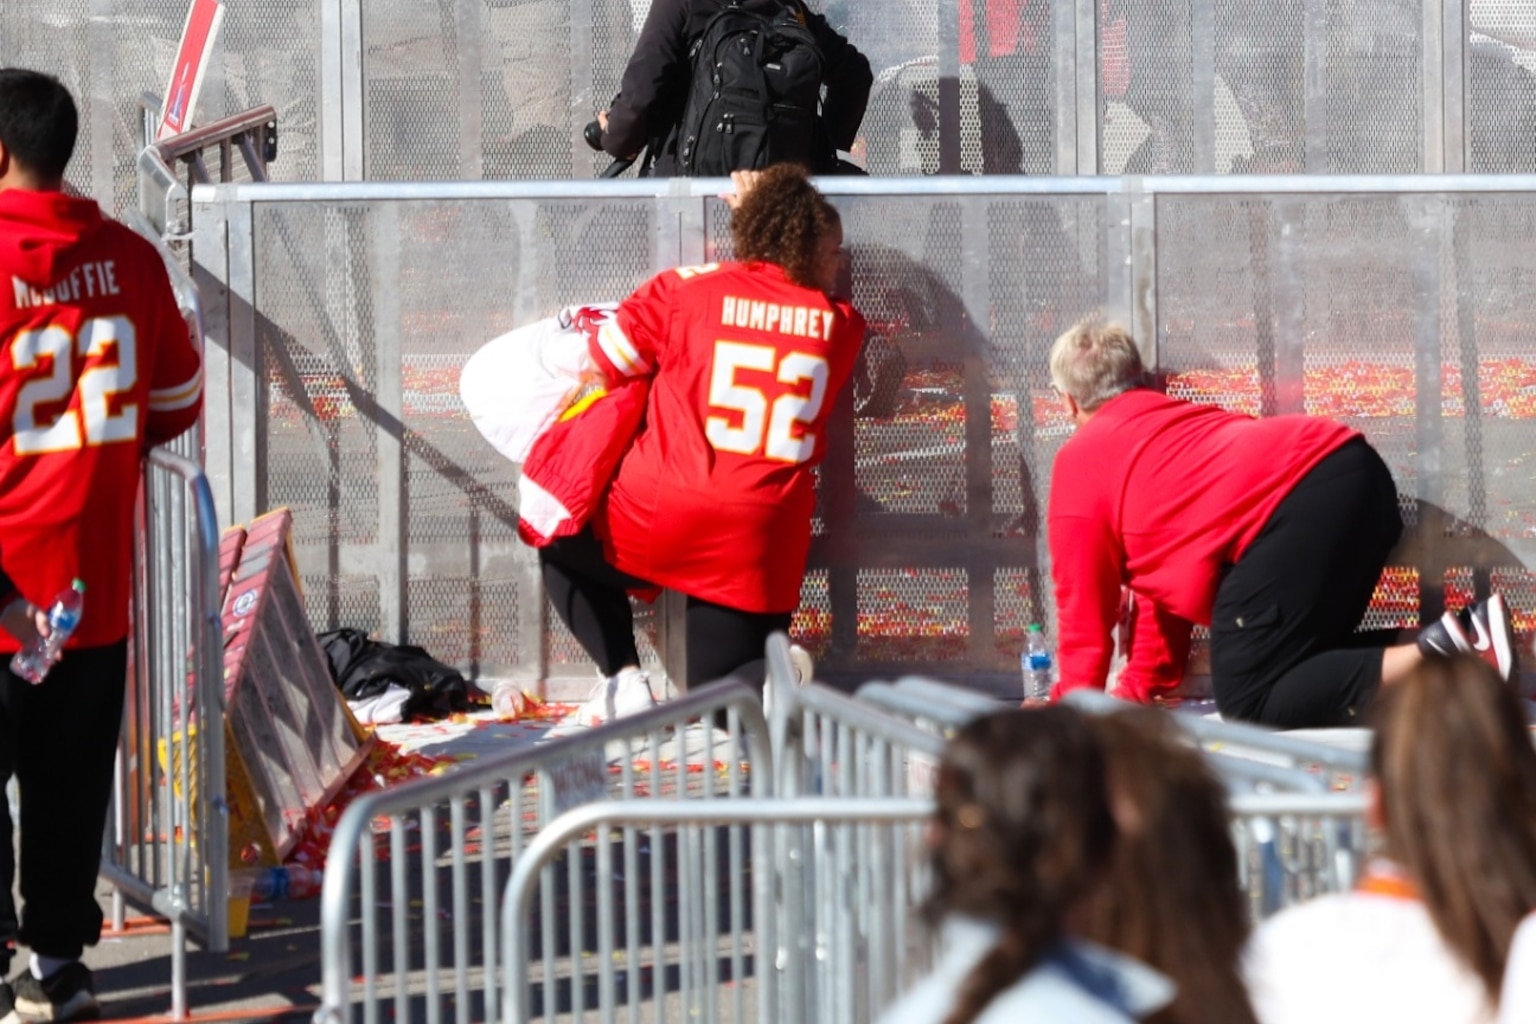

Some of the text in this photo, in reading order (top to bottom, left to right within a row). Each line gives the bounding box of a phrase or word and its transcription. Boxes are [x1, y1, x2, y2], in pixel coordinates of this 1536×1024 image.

[721, 294, 835, 341] HUMPHREY
[10, 313, 139, 456] 22
[705, 339, 830, 464] 52
